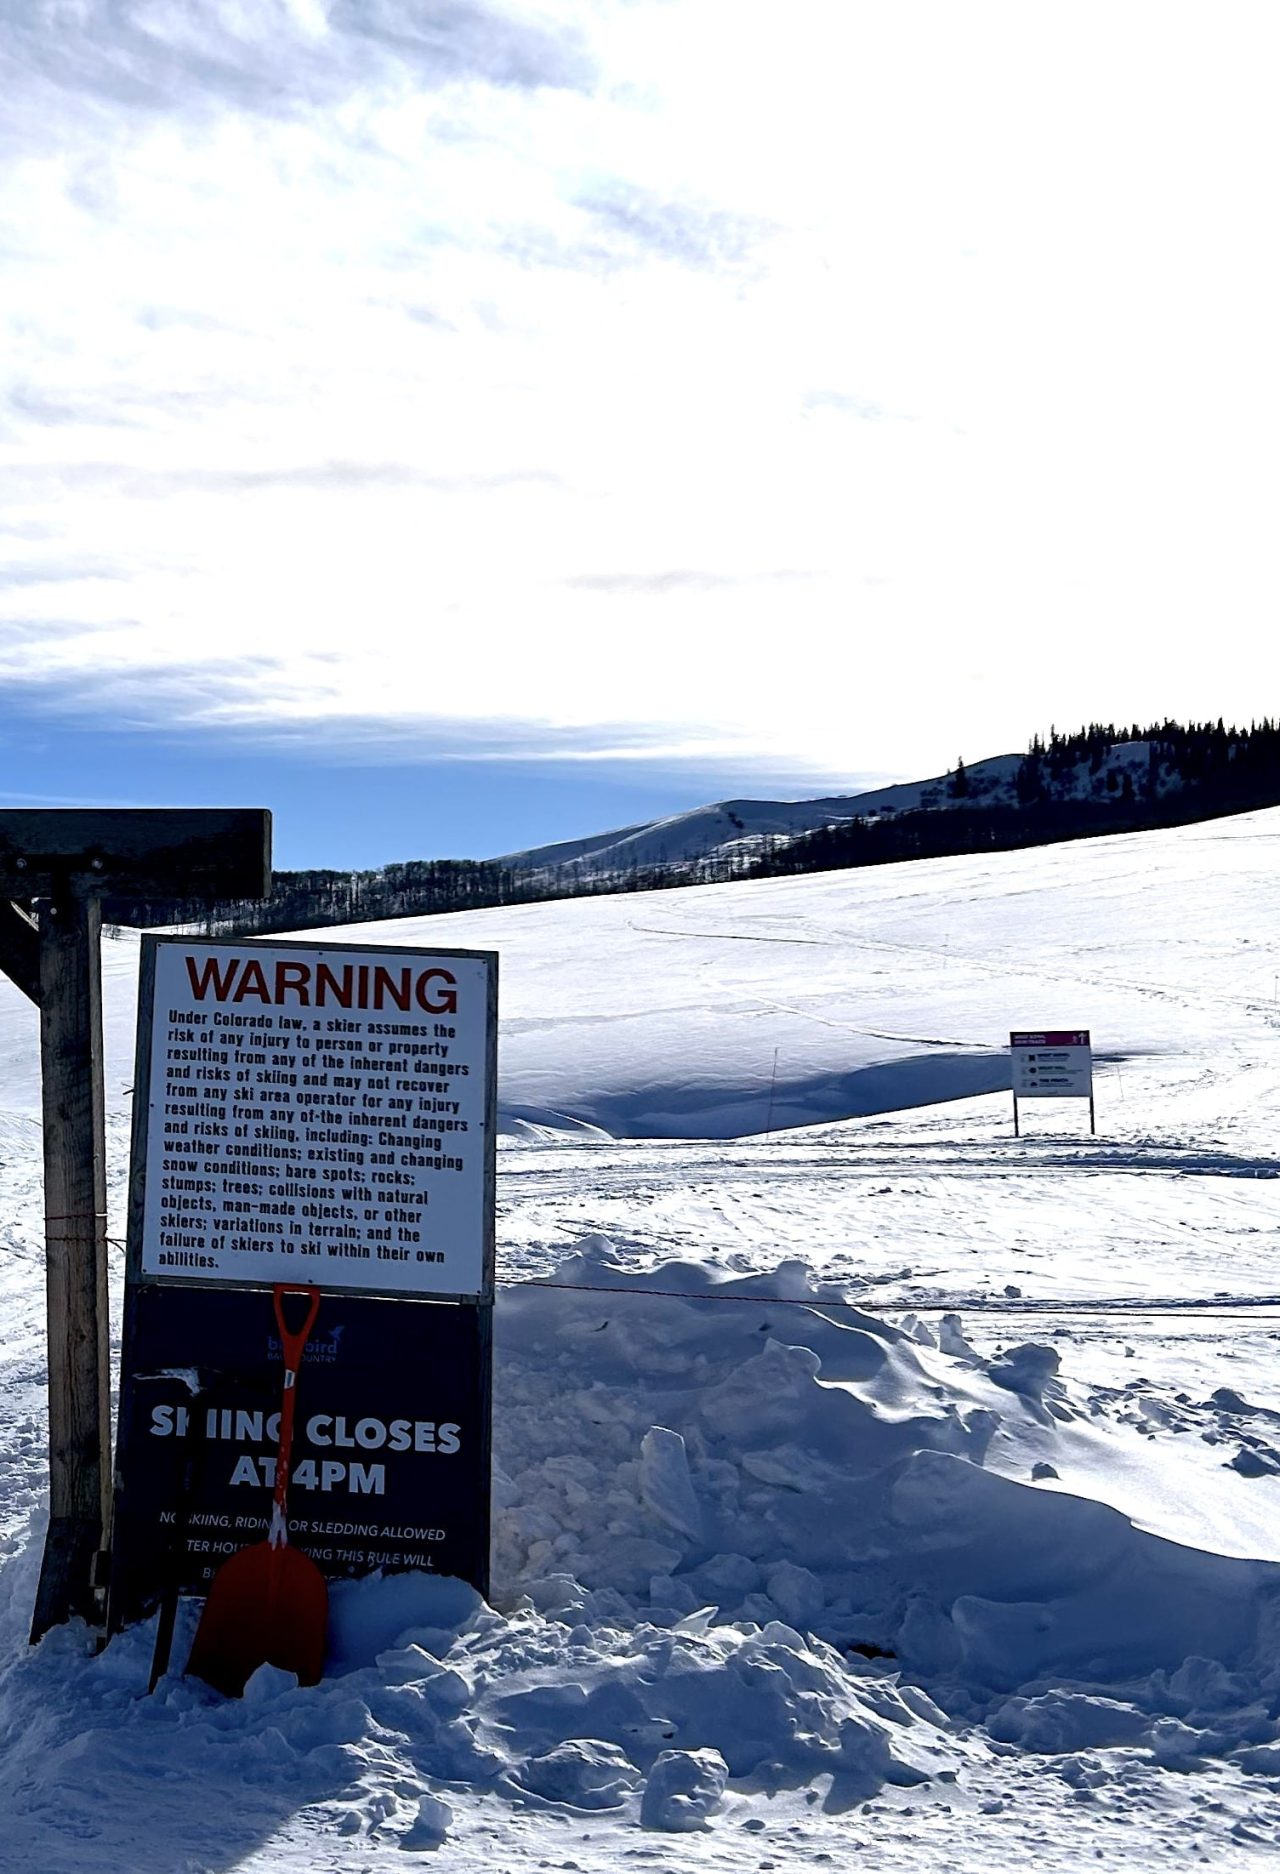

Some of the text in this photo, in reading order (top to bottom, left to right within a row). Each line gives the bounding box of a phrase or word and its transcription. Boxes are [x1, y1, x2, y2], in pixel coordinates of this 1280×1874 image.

[185, 956, 459, 1015] WARNING
[168, 1009, 456, 1039] Under Colorado law, a skier assumes the
[167, 1027, 449, 1059] risk of any injury to person or property
[166, 1047, 470, 1077] resulting from any of the inherent dangers
[166, 1064, 450, 1094] and risks of skiing and may not recover
[165, 1082, 460, 1115] from any ski area operator for any injury
[164, 1102, 227, 1121] resulting
[232, 1104, 264, 1121] from
[269, 1109, 295, 1124] any
[348, 1111, 407, 1128] inherent
[412, 1115, 469, 1134] dangers
[164, 1120, 442, 1152] and risks of skiing, including: Changing
[163, 1139, 464, 1172] weather conditions; existing and changing
[162, 1159, 416, 1186] snow conditions; bare spots; rocks;
[161, 1175, 429, 1206] stumps; trees; collisions with natural
[160, 1193, 422, 1224] objects, man-made objects, or other
[160, 1212, 421, 1243] skiers; variations in terrain; and the
[158, 1250, 219, 1269] abilities.
[159, 1231, 445, 1264] failure of skiers to ski within their own
[267, 1335, 337, 1353] bbird
[306, 1414, 461, 1454] CLOSES
[228, 1455, 386, 1495] AT 4PM
[188, 1513, 232, 1529] KIING,
[235, 1516, 272, 1529] RIDIN
[288, 1519, 308, 1532] OR
[310, 1521, 379, 1537] SLEDDING
[380, 1526, 446, 1541] ALLOWED
[186, 1539, 211, 1552] TER
[335, 1549, 364, 1563] THIS
[367, 1551, 401, 1566] RULE
[403, 1553, 434, 1567] WILL
